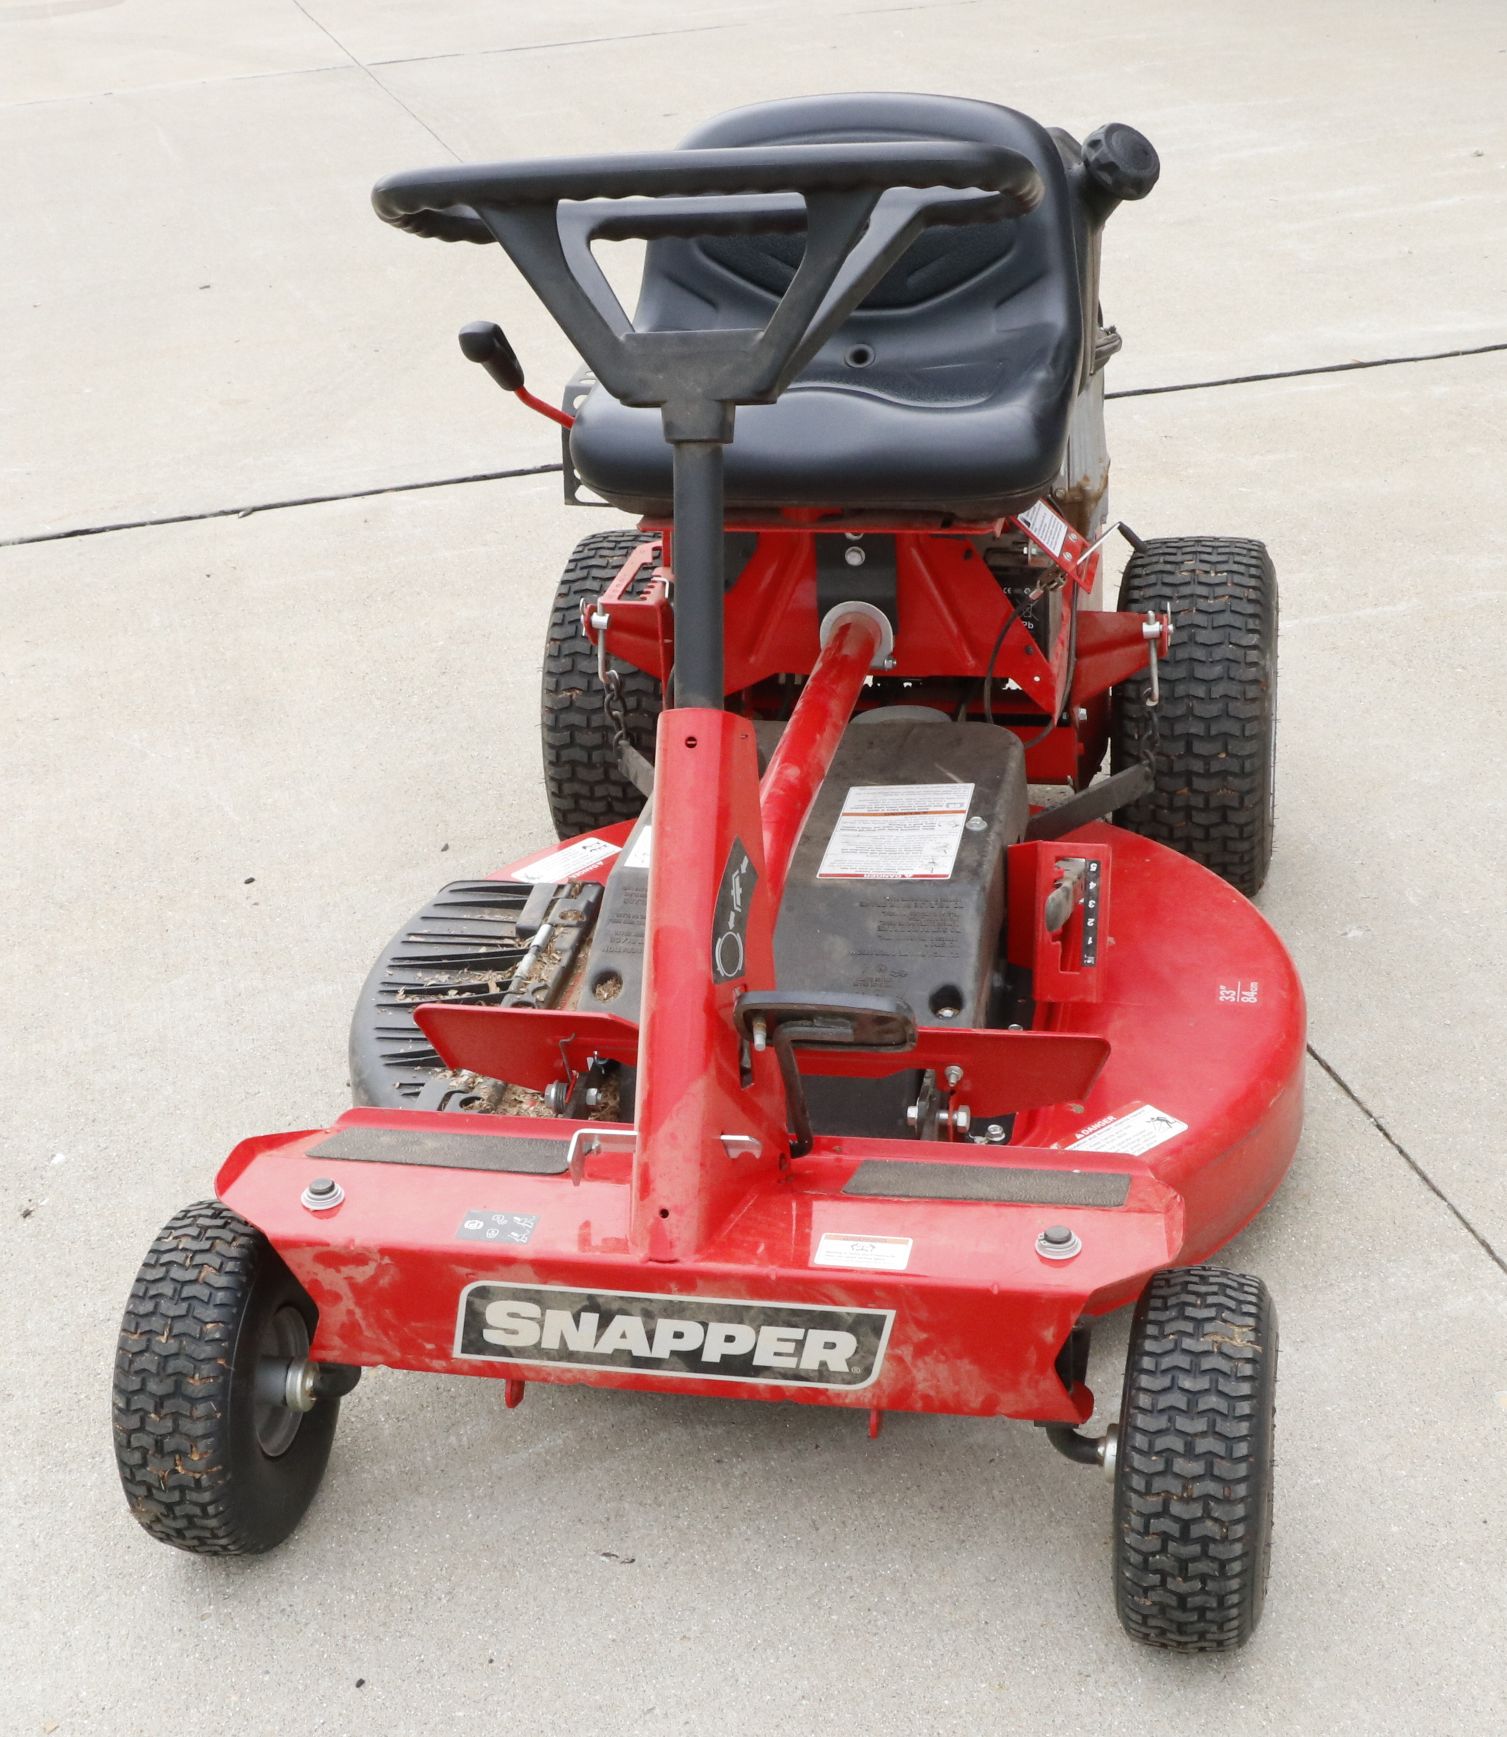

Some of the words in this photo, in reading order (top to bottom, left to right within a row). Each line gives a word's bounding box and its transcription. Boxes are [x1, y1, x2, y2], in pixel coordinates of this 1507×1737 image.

[1089, 863, 1098, 872] 5
[1088, 881, 1097, 890] 4
[1088, 900, 1096, 908] 3
[1087, 918, 1095, 926] 2
[1087, 936, 1093, 945] 1
[1219, 985, 1236, 1002] 33"
[1081, 1115, 1117, 1136] DANGER
[483, 1300, 858, 1372] SNAPPER
